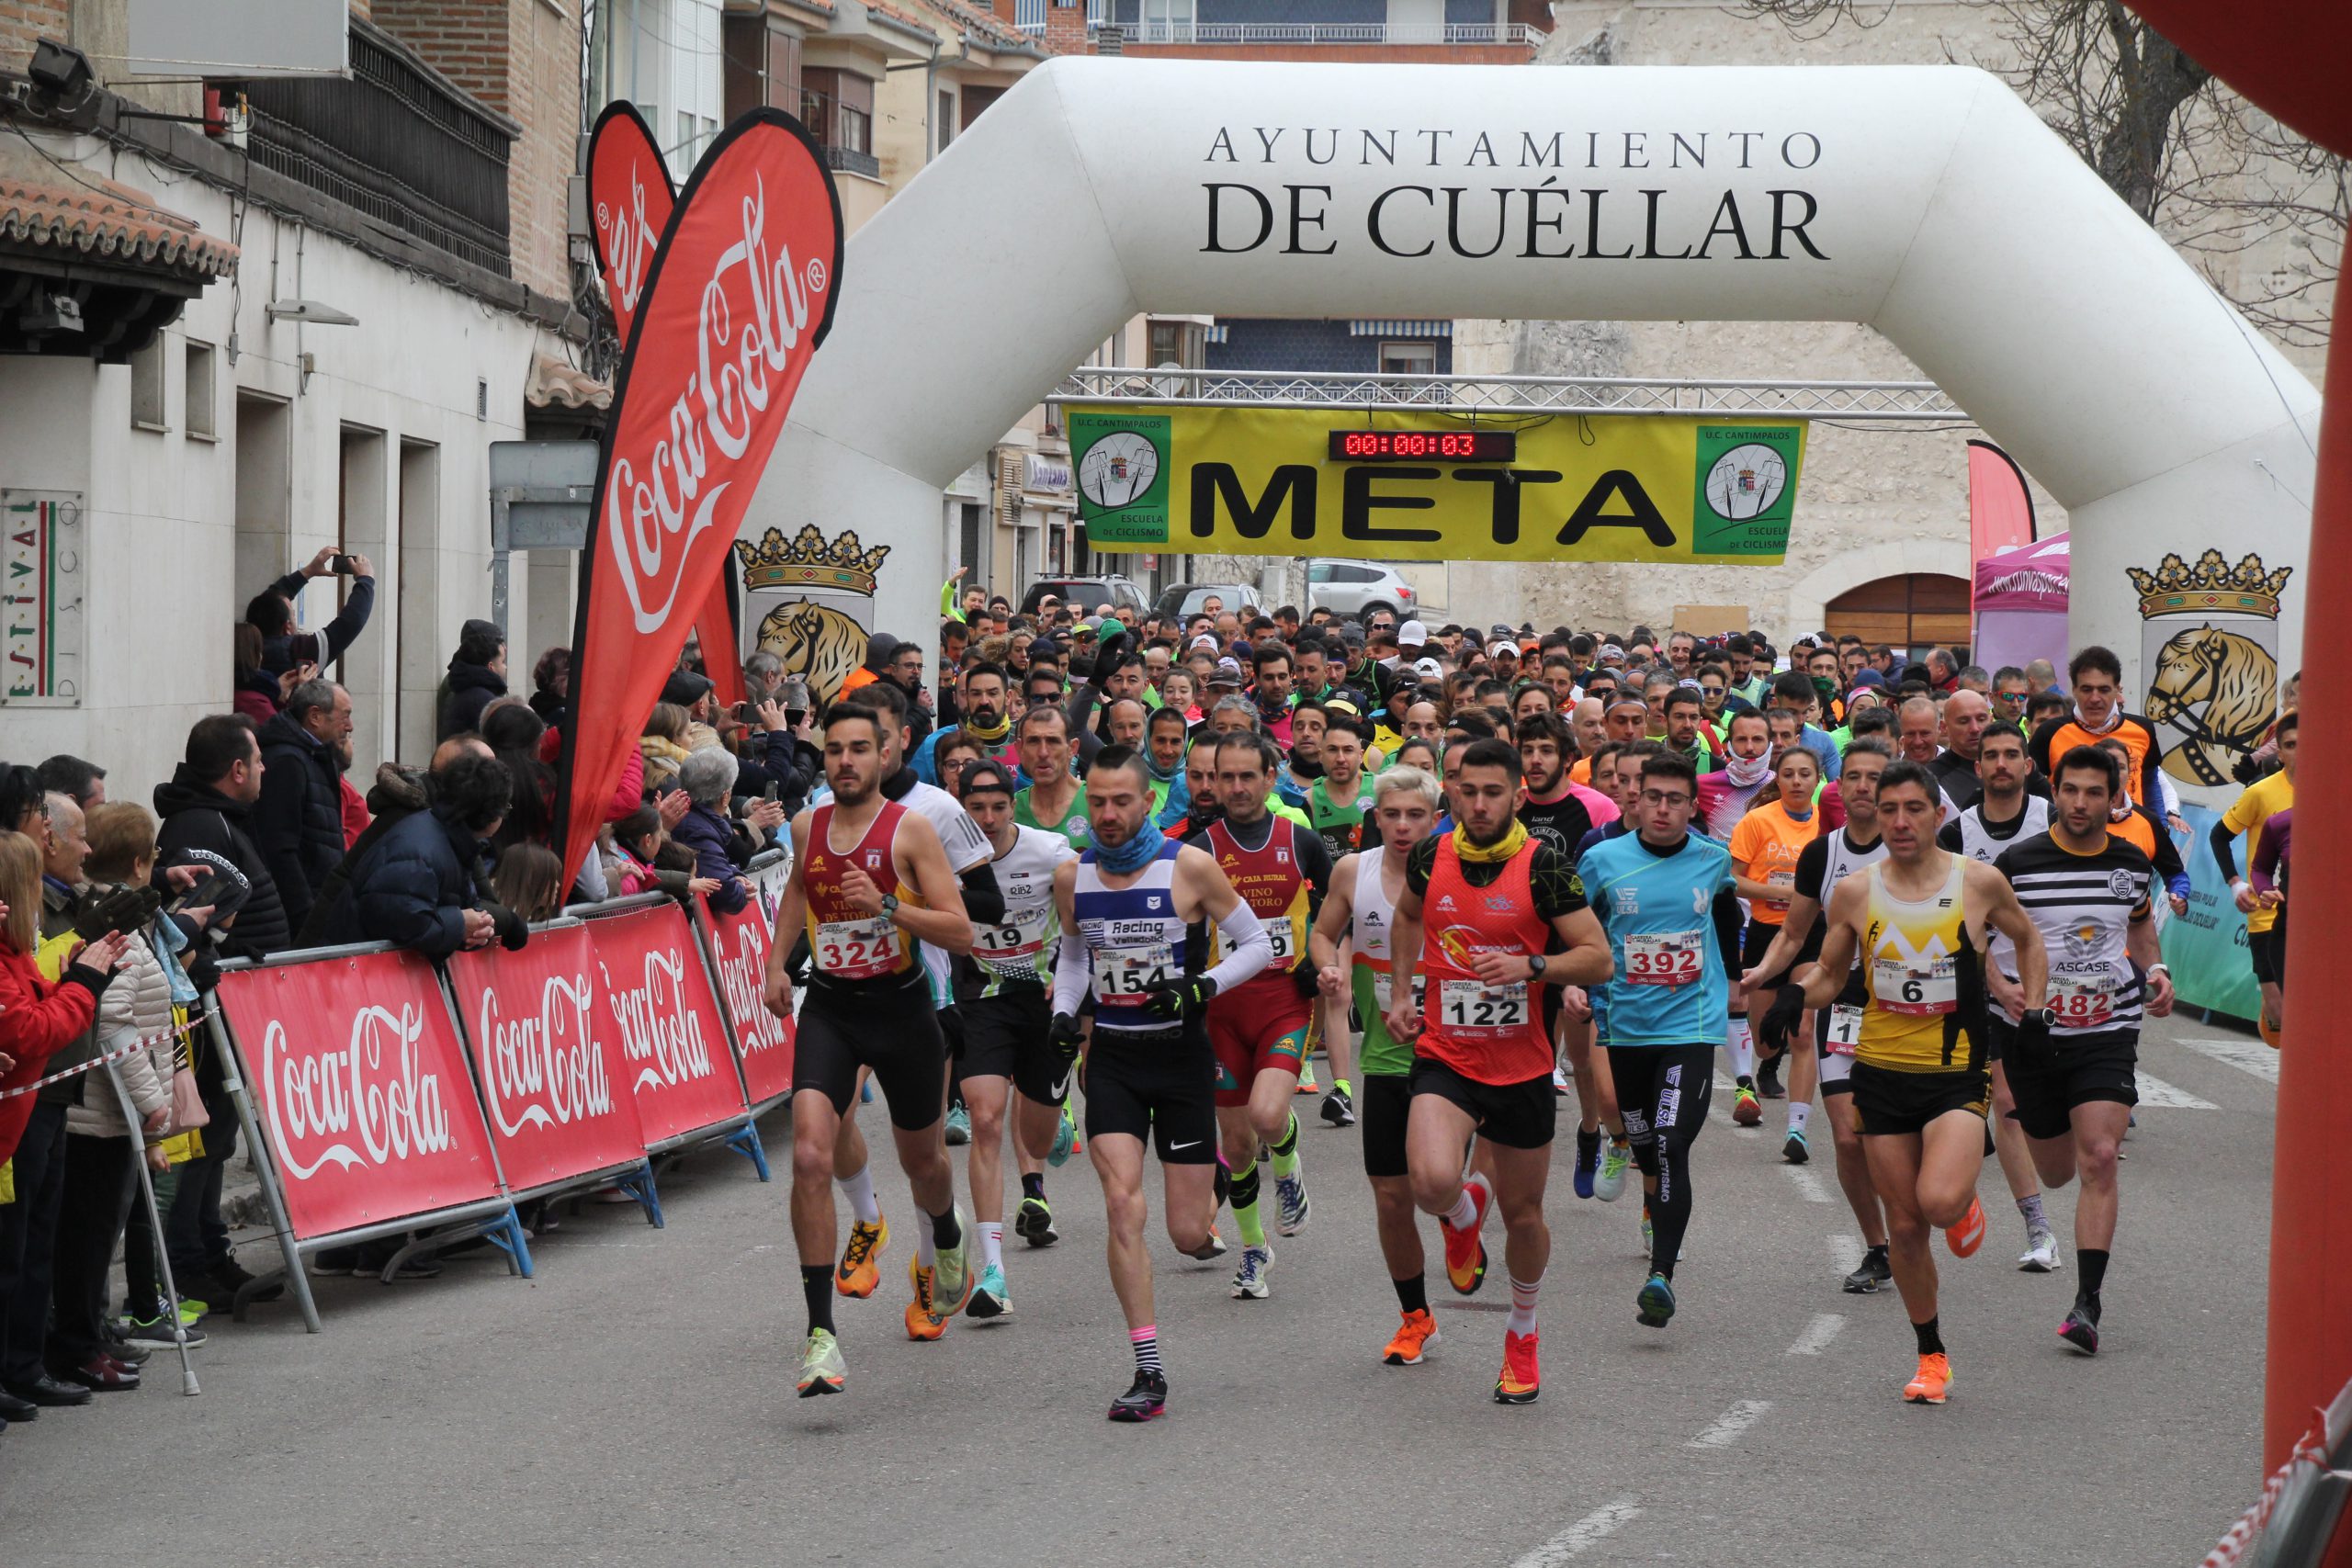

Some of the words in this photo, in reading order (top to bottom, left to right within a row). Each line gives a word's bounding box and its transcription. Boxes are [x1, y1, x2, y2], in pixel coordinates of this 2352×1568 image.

[1204, 126, 1823, 170] AYUNTAMIENTO
[1200, 182, 1338, 255] DE
[1367, 176, 1831, 261] CUÉLLAR
[609, 169, 810, 634] Coca-Cola
[1097, 419, 1162, 429] CANTIMPALOS
[1705, 431, 1723, 439] U.C.
[1724, 431, 1791, 440] CANTIMPALOS
[1345, 432, 1474, 455] 00:00:03
[1190, 461, 1677, 548] META
[1121, 514, 1163, 524] ESCUELA
[1103, 528, 1114, 536] DE
[1115, 528, 1163, 536] CICLISMO
[1748, 527, 1788, 536] ESCUELA
[1743, 541, 1788, 549] CICLISMO
[58, 501, 77, 696] DISCO
[830, 885, 842, 894] CA
[1243, 874, 1262, 883] CAJA
[1242, 888, 1273, 898] VINO
[1250, 897, 1283, 908] TORO
[831, 900, 854, 910] VIN
[1080, 921, 1102, 931] RACING
[1113, 920, 1165, 934] Racing
[982, 928, 1023, 950] 19
[1113, 935, 1164, 945] Valladolid
[823, 934, 893, 968] 324
[1632, 950, 1697, 974] 392
[2055, 961, 2110, 973] ASCASE
[1102, 966, 1166, 994] 154
[1902, 980, 1924, 1003] 6
[1451, 1000, 1521, 1025] 122
[2045, 993, 2109, 1016] 482
[481, 973, 611, 1138] Coca-Cola
[263, 998, 452, 1179] Coca-Cola
[1654, 1088, 1675, 1129] ULSA
[1668, 1089, 1681, 1127] COMERCIAL
[1657, 1134, 1670, 1202] ATLETISMO
